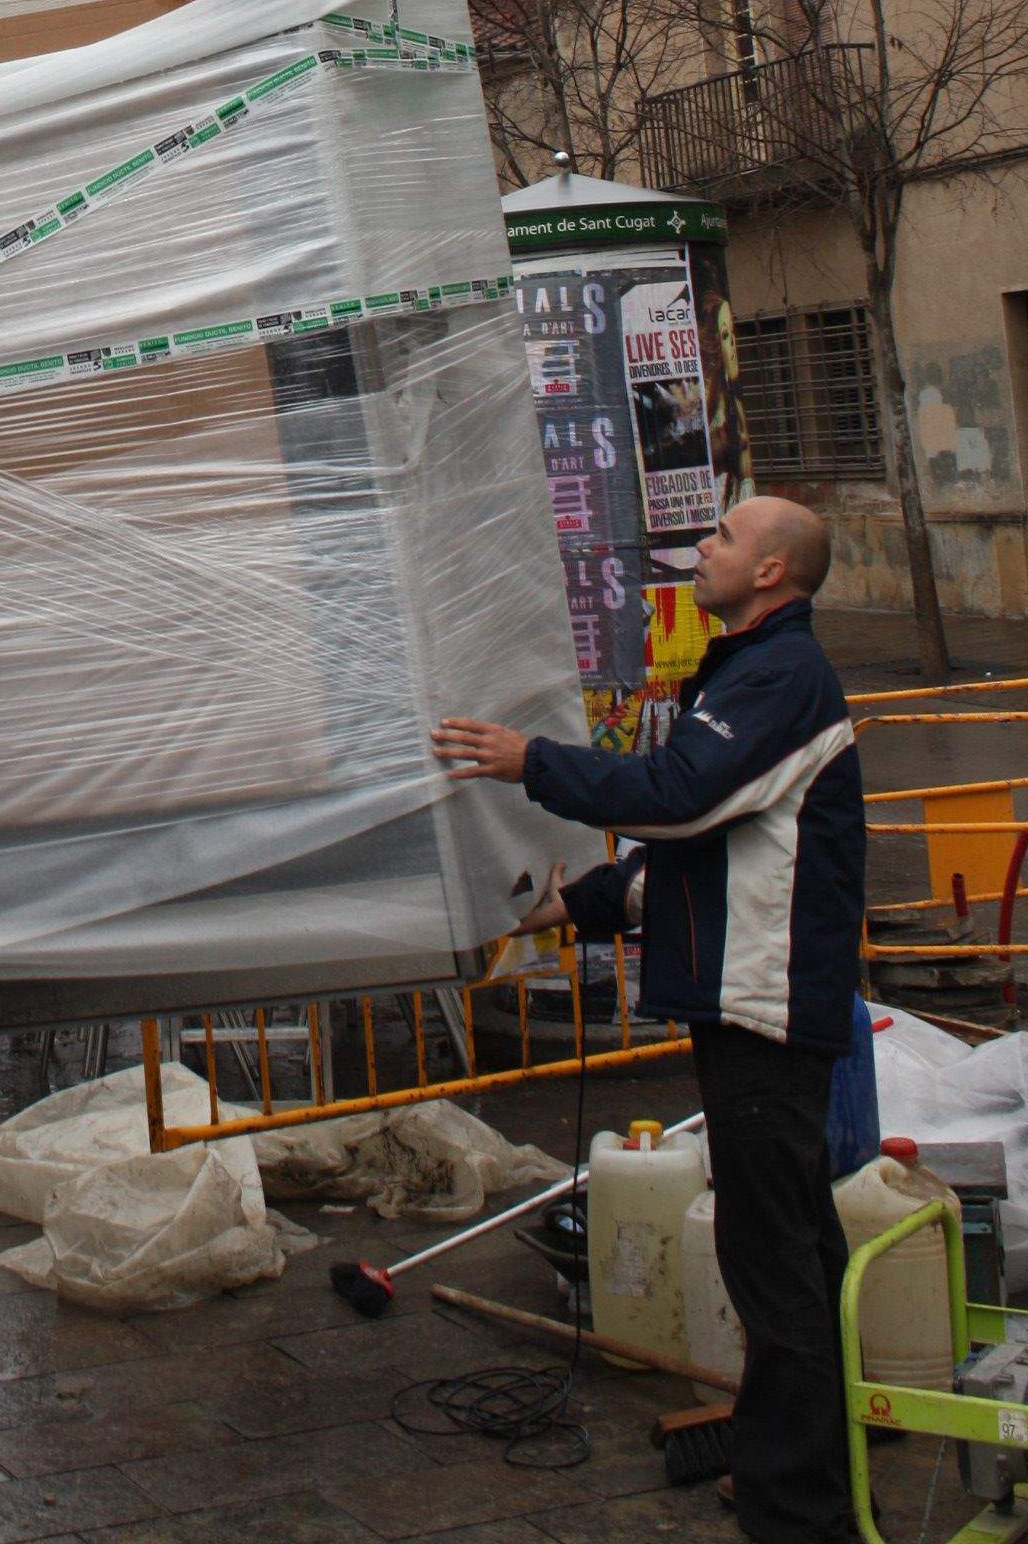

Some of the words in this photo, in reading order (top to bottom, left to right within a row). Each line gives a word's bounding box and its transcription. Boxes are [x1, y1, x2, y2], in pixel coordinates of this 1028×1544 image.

[507, 222, 552, 237] ament
[557, 219, 575, 232] de
[580, 216, 611, 230] Sant
[615, 215, 655, 231] Cugat
[626, 331, 665, 364] LIVE
[1002, 1422, 1016, 1440] 97
